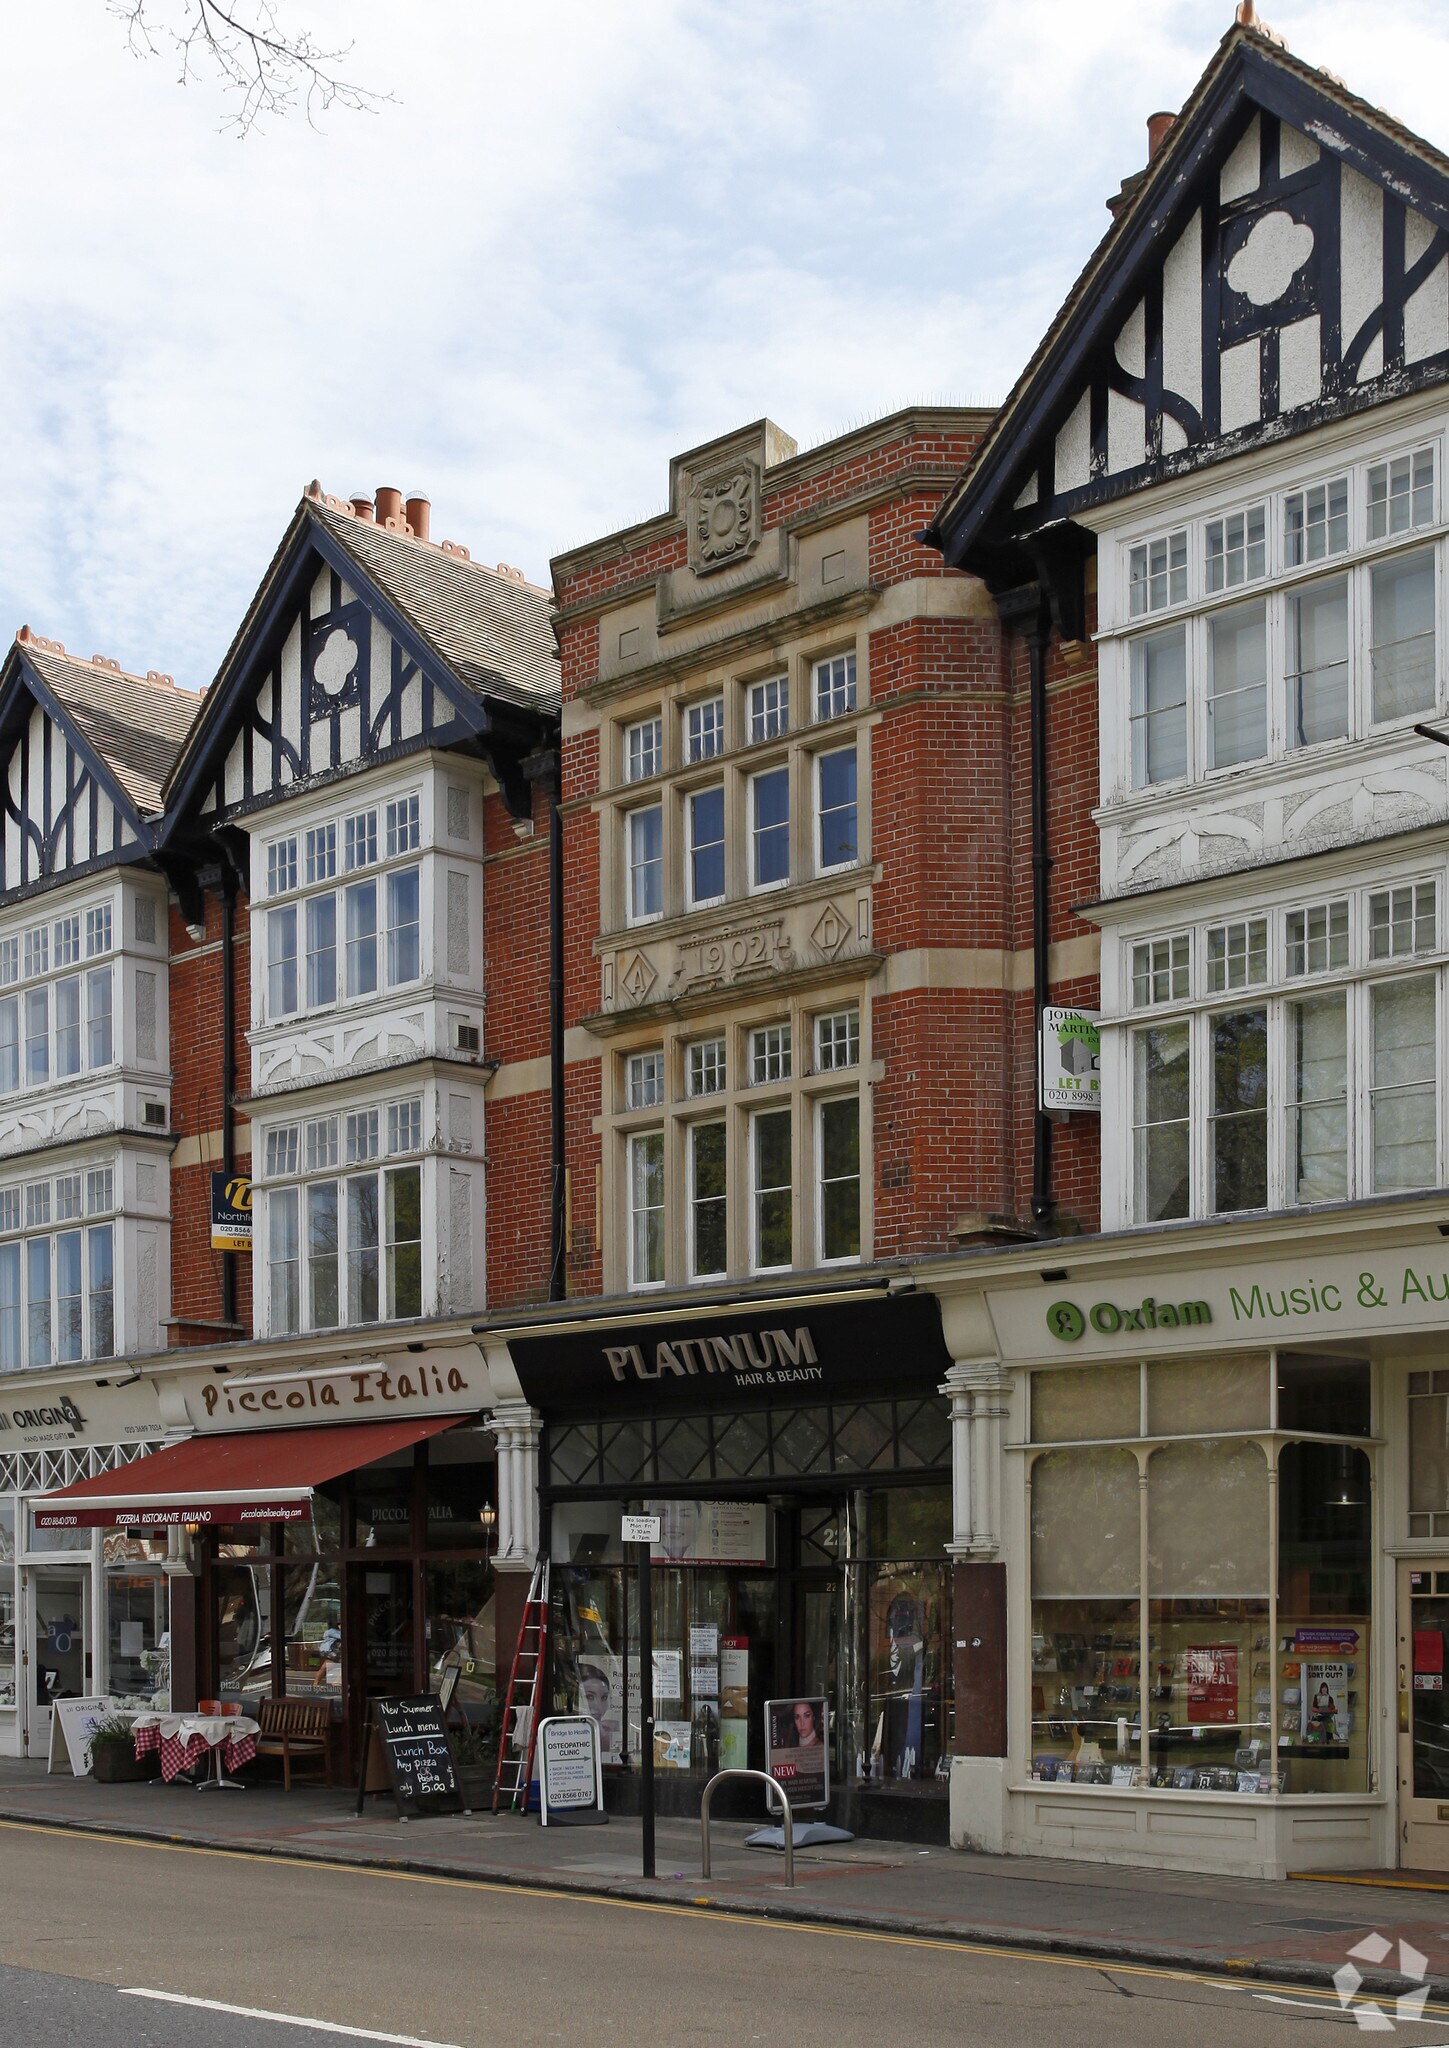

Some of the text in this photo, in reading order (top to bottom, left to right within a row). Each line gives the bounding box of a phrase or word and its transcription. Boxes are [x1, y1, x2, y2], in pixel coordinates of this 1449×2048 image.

[631, 918, 840, 994] A 1902 D
[1048, 1010, 1082, 1021] JOHN
[1048, 1022, 1098, 1035] MARTIN
[1058, 1077, 1100, 1091] LET B
[1048, 1090, 1068, 1100] 020
[1071, 1091, 1094, 1101] 8998
[1089, 1297, 1213, 1334] Oxfam
[1229, 1278, 1342, 1321] Music
[1356, 1272, 1388, 1309] &
[602, 1326, 819, 1382] PLATINUM
[734, 1367, 823, 1386] HAIR & BEAUTY
[201, 1365, 469, 1416] Piccola Italia
[124, 1426, 135, 1434] 020
[135, 1425, 149, 1433] 3689
[24, 1432, 69, 1443] HAND MADE GIFTS
[115, 1511, 212, 1524] PIZZERIA RISTORANTE ITALIANO
[240, 1507, 302, 1520] piccolaitaliaealing.com
[371, 1506, 454, 1521] PICCOL ALIA
[40, 1517, 52, 1526] 020
[1190, 1649, 1223, 1660] SYRIA
[1190, 1662, 1226, 1673] CRISIS
[1191, 1673, 1233, 1685] APPEAL
[220, 1681, 240, 1691] pizza
[611, 1683, 640, 1691] Yohfu
[75, 1702, 107, 1712] ORIGINL
[381, 1701, 433, 1714] New Summer
[385, 1719, 440, 1734] Lunch menu
[550, 1730, 567, 1738] Bridge
[393, 1740, 449, 1757] Lunch Box
[548, 1741, 590, 1750] OSTEOPATHIC
[559, 1749, 580, 1757] CLINIC
[396, 1758, 437, 1772] Any pizza
[773, 1765, 796, 1777] NEW
[417, 1772, 440, 1783] Pasta
[399, 1782, 446, 1795] only 5.00
[577, 1790, 592, 1798] 0767
